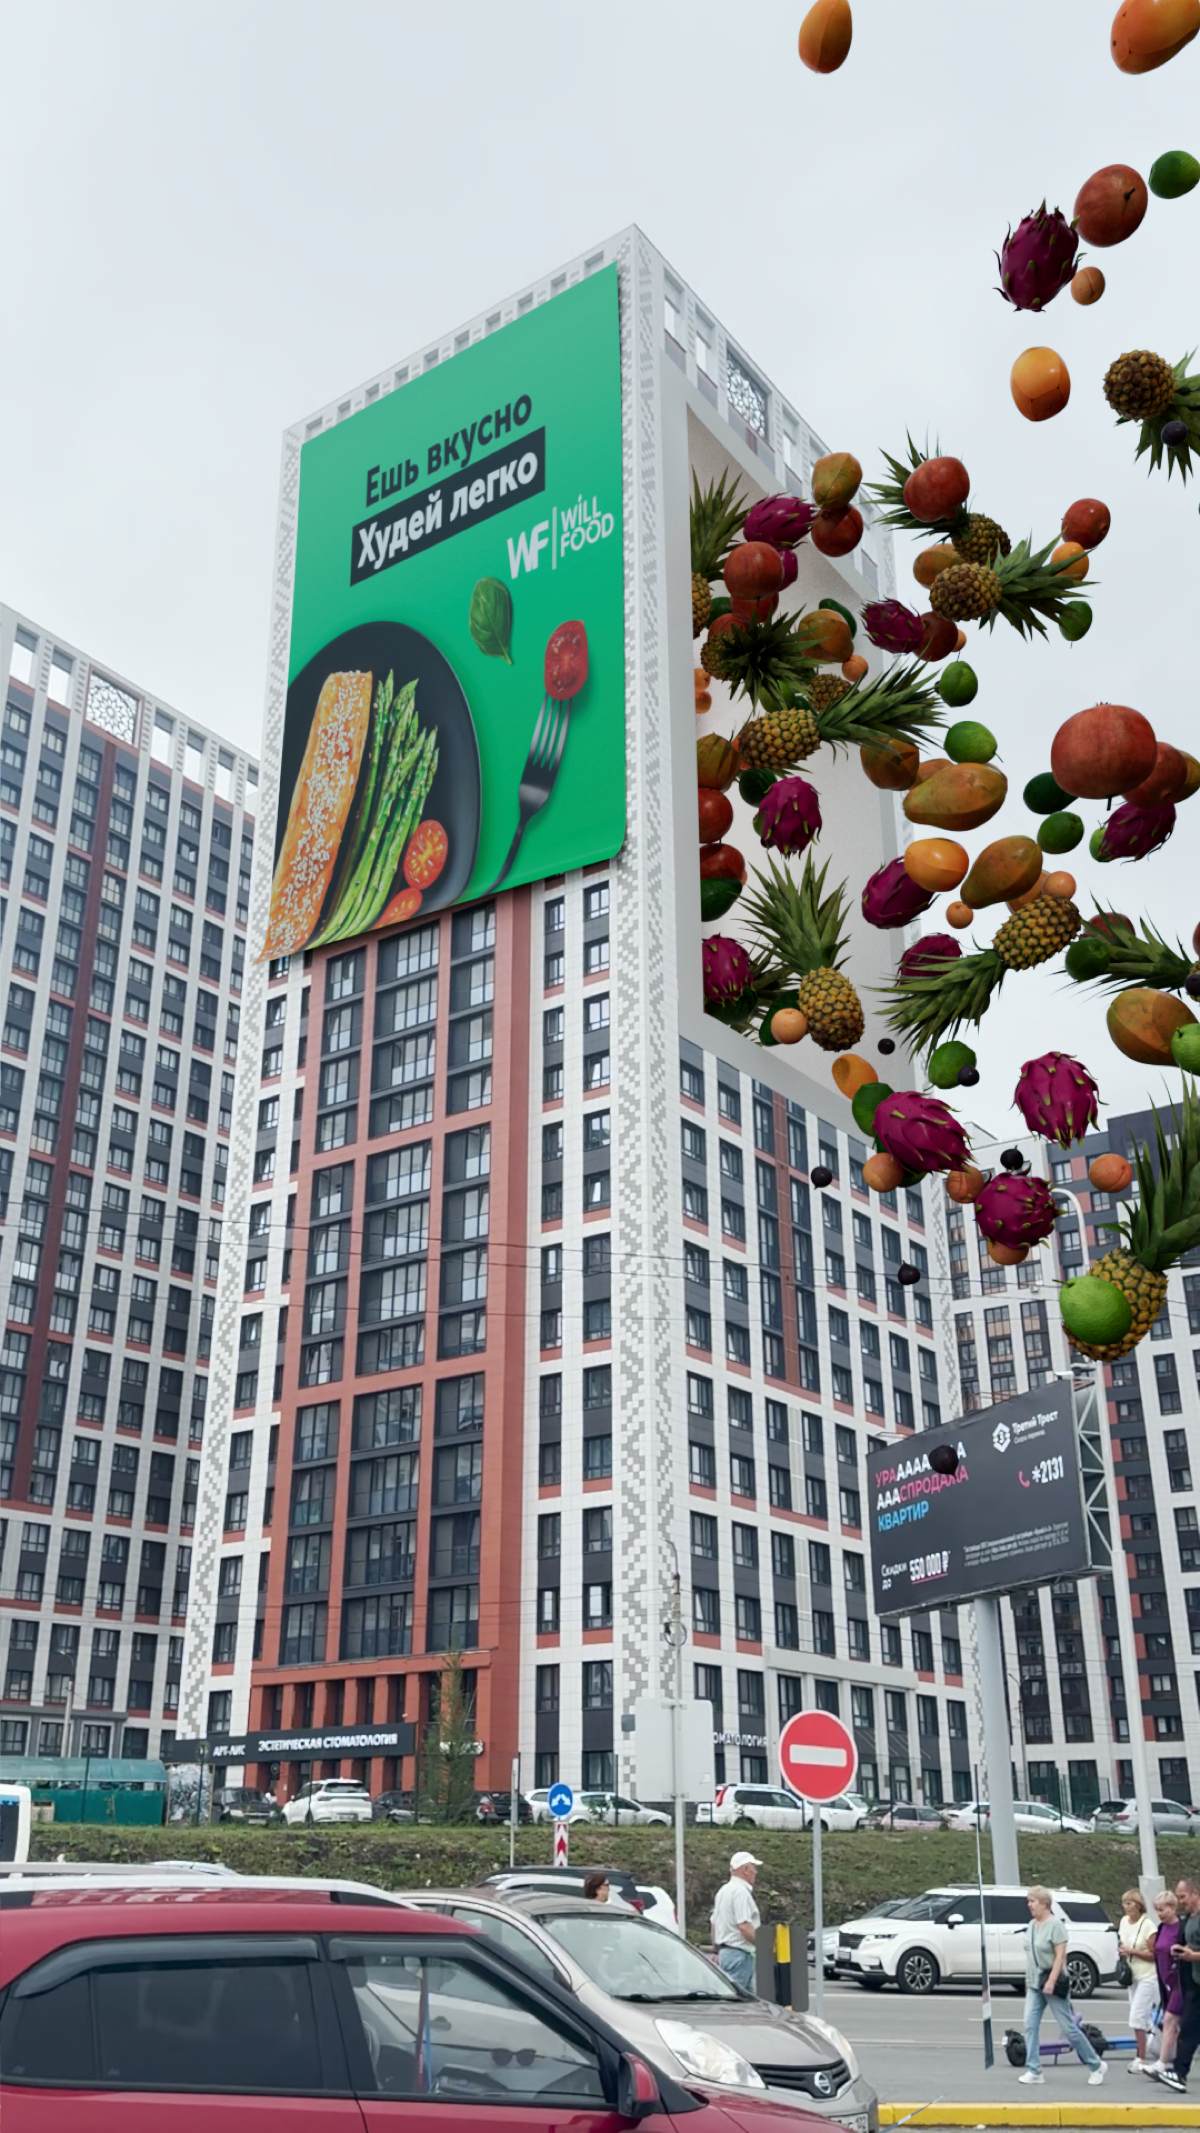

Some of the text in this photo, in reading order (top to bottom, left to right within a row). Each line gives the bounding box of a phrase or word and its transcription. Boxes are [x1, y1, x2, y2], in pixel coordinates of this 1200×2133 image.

[366, 394, 532, 508] Ешь вкусно
[357, 452, 538, 570] Худей легко
[506, 519, 549, 580] WF
[561, 512, 615, 558] FOOD
[1037, 1410, 1059, 1427] Трест
[875, 1441, 967, 1489] УРАААААА
[877, 1500, 930, 1532] КВАРТИР
[881, 1562, 907, 1577] Скидки
[909, 1556, 925, 1582] 550
[925, 1552, 942, 1577] 000
[258, 1737, 322, 1752] ЭСТЕТИЧЕСКАЯ
[323, 1733, 398, 1749] СТОМАТОЛОГИЯ
[712, 1731, 768, 1747] ОМАТОЛОГИЯ
